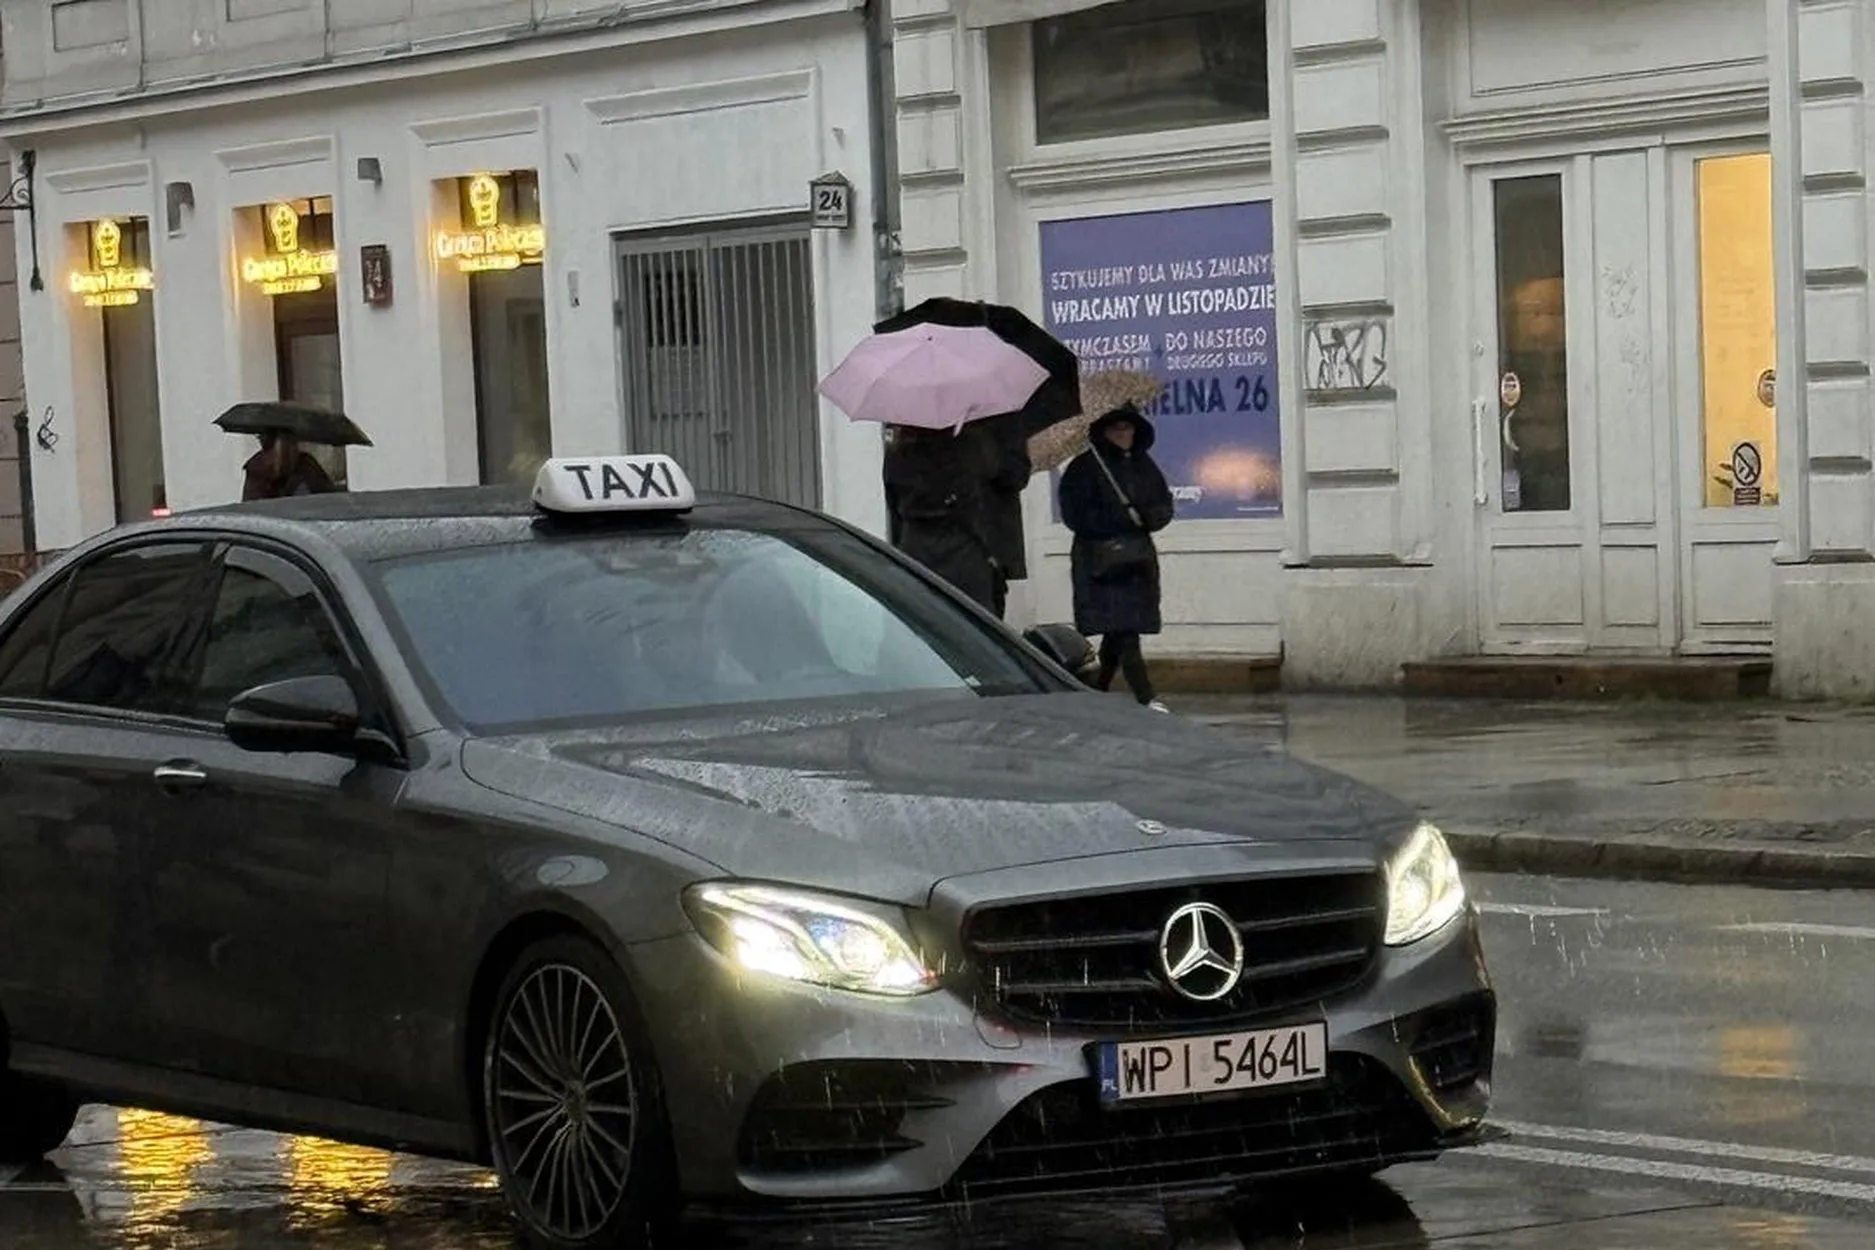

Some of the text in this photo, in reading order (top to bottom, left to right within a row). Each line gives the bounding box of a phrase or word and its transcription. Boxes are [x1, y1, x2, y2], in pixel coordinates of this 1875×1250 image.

[819, 190, 842, 210] 24
[1051, 266, 1133, 291] SZYKUJEMY
[1138, 264, 1166, 284] DLA
[1170, 260, 1204, 281] WAS
[1052, 284, 1275, 324] WRACAMY W LISTOPADZIE
[1165, 326, 1267, 351] DO NASZEGO
[1143, 375, 1269, 416] IELNA 26
[563, 461, 679, 500] TAXI
[1213, 1031, 1320, 1084] 5464L
[1102, 1078, 1117, 1092] PL
